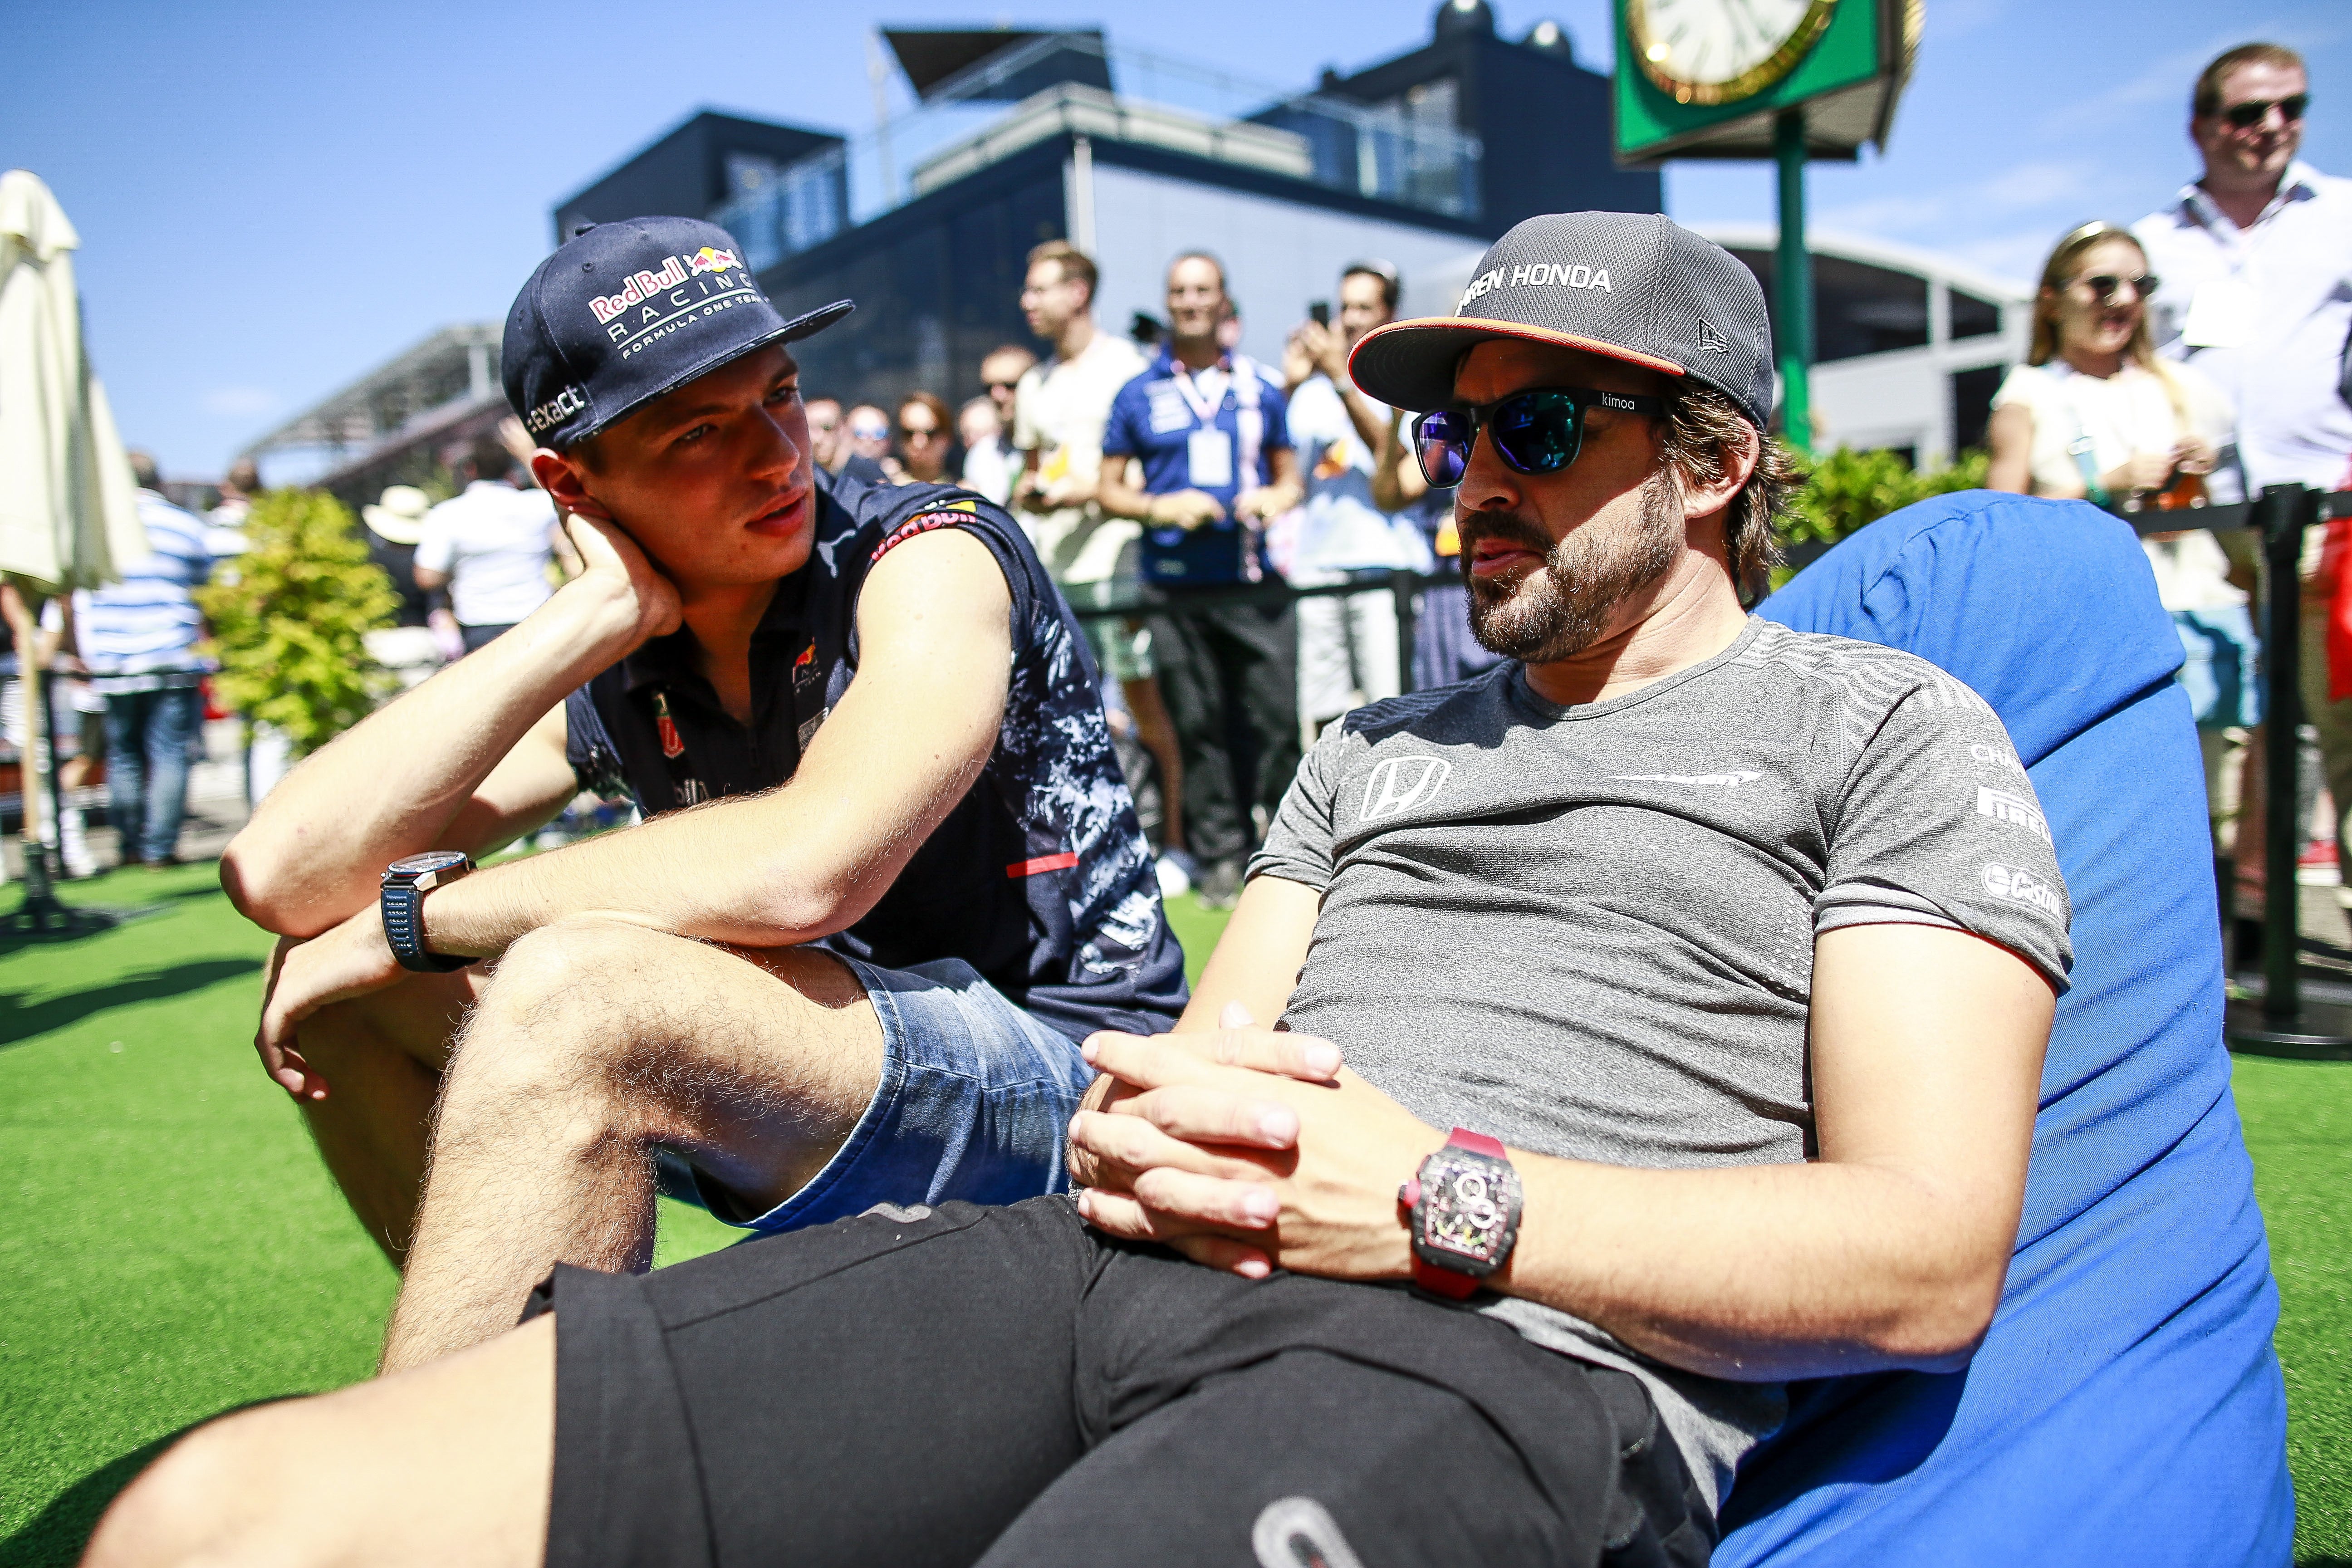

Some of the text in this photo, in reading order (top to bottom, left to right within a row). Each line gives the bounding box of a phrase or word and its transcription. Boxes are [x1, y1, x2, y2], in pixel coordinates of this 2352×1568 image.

[589, 256, 688, 324] Red Bull
[1510, 263, 1612, 294] HONDA
[607, 273, 753, 343] RACING
[622, 314, 698, 361] FORMULA
[703, 299, 734, 317] ONE
[1602, 392, 1635, 410] kimoa
[2010, 871, 2062, 919] Castrol
